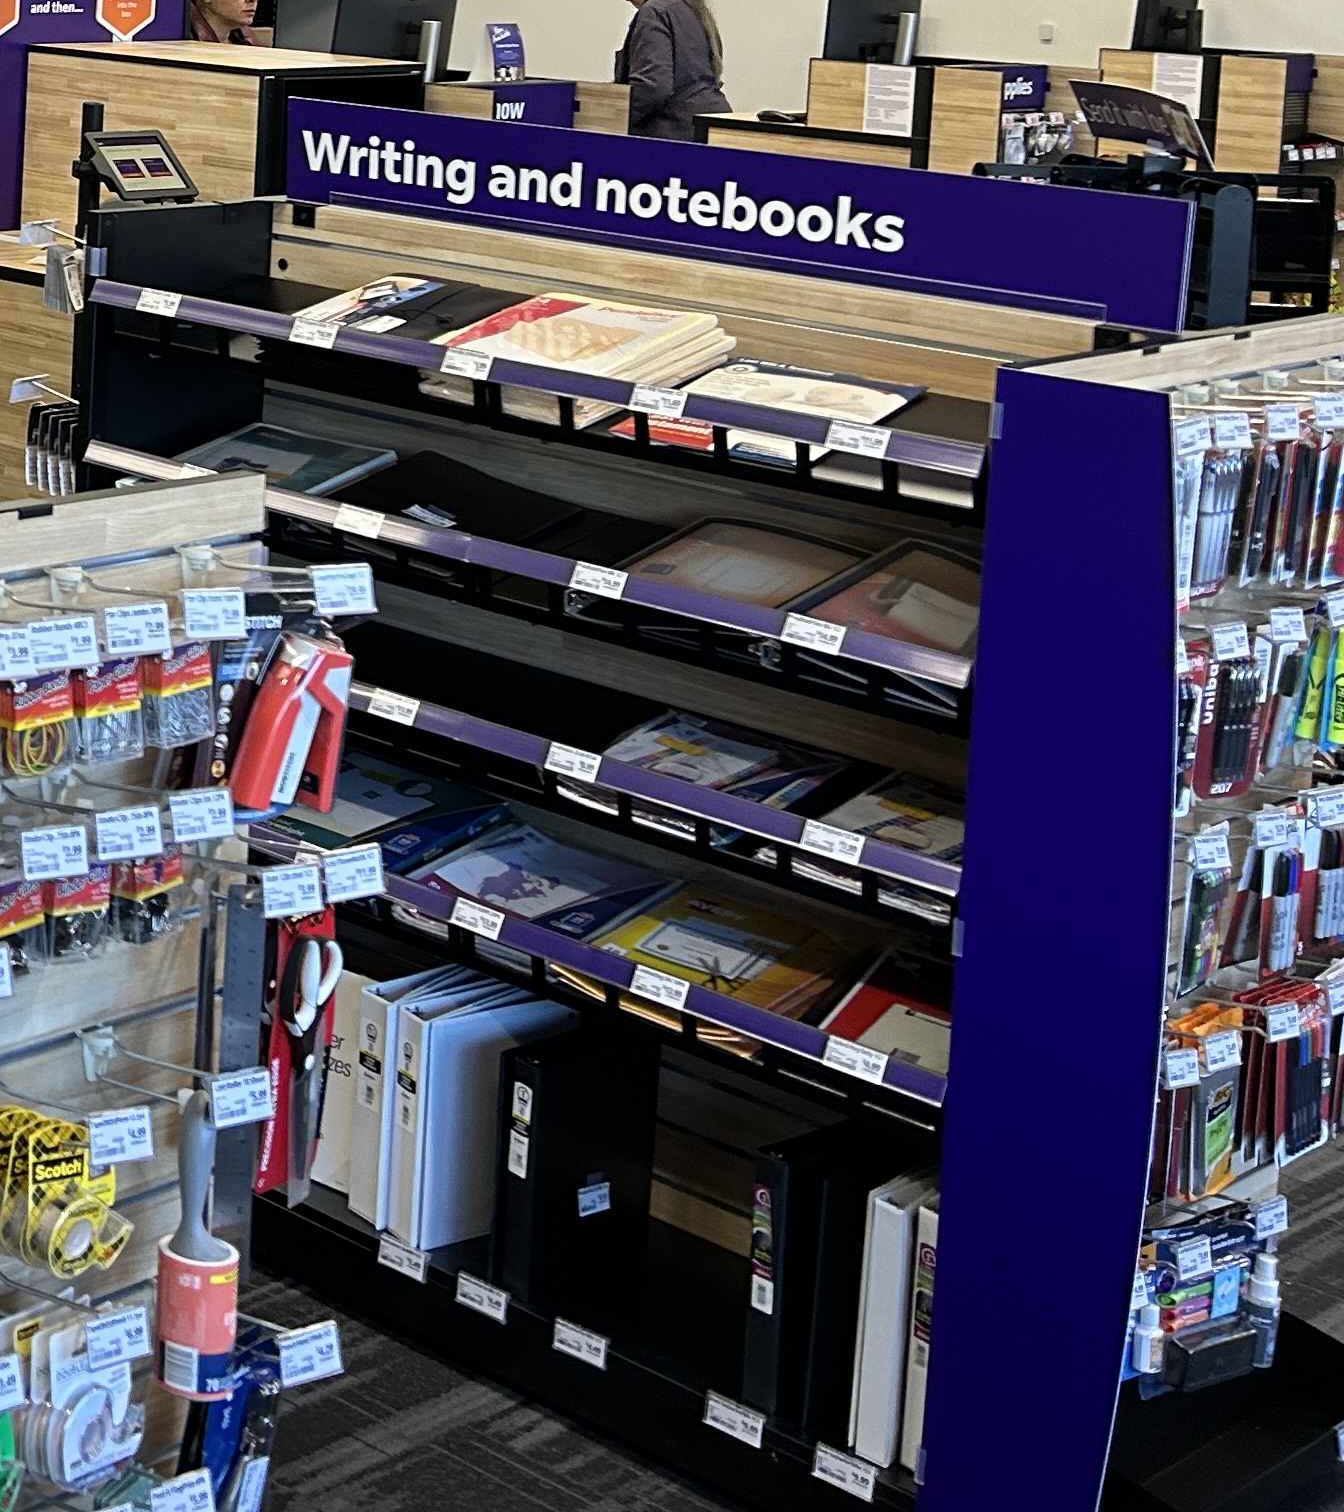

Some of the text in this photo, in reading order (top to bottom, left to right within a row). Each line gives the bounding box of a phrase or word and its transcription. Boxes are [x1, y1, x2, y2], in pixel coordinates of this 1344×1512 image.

[30, 1, 50, 14] and
[1003, 76, 1034, 101] pplies
[301, 129, 907, 254] Writing and notebooks
[649, 418, 712, 435] stament
[1210, 782, 1233, 795] 207
[330, 1034, 345, 1051] er
[328, 1058, 352, 1078] zes
[35, 1161, 82, 1181] Scotch
